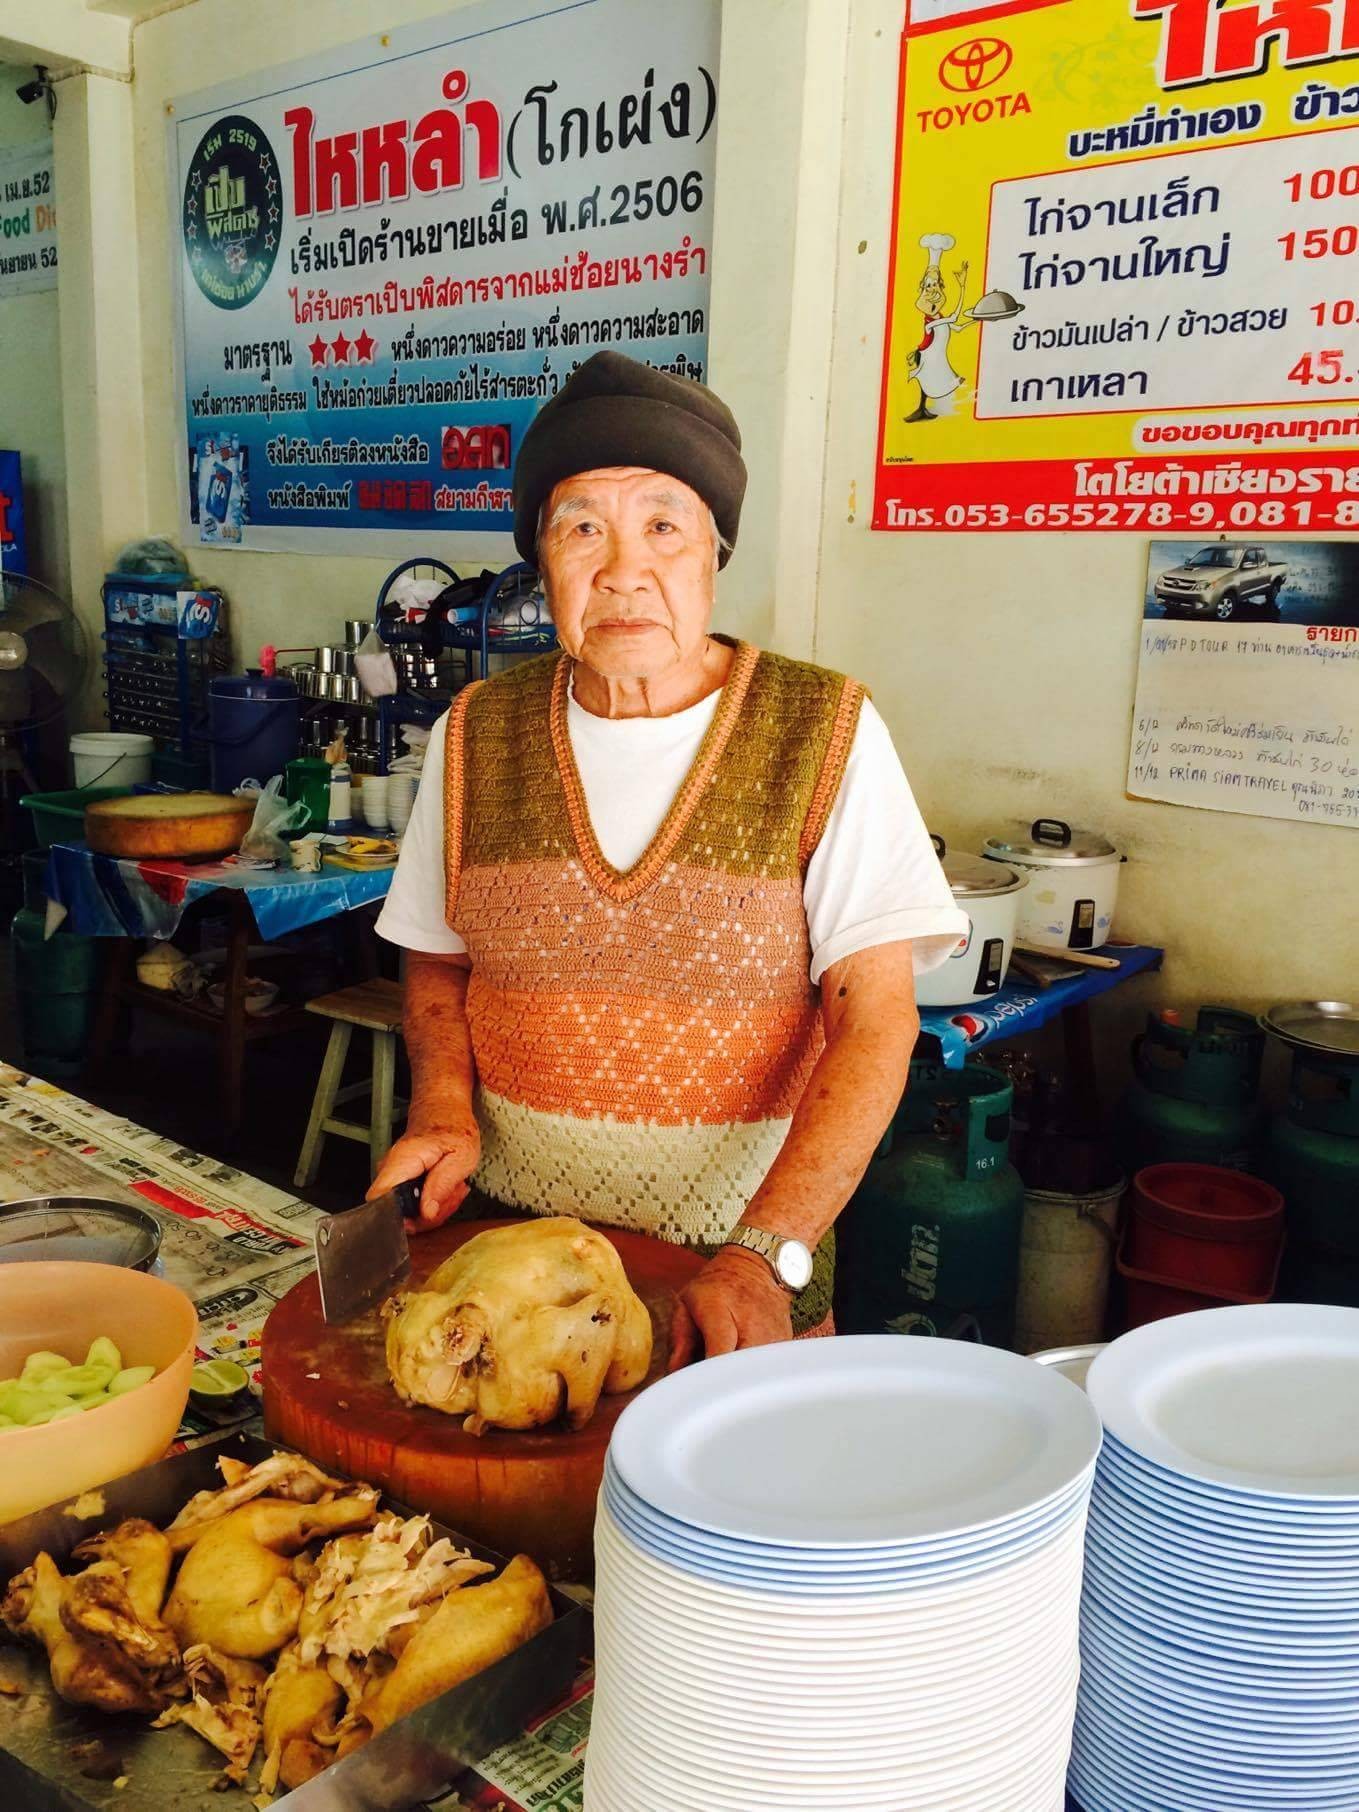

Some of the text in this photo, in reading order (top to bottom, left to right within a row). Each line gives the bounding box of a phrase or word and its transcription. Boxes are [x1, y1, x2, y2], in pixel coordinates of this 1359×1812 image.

[917, 92, 1032, 134] TOYOTA
[1069, 107, 1262, 156] บะหมี่ทำเอง
[228, 128, 257, 152] 2519
[284, 66, 717, 217] ไหหลำ (โกเผ่ง)
[0, 207, 31, 239] ood
[291, 170, 703, 275] เริ่มเปิดร้านขายเมื่อ พ.ศ.2506
[1024, 176, 1220, 236] ไก่จานเล็ก
[41, 246, 58, 268] 52
[1019, 232, 1231, 291] ไก่จานใหญ่
[290, 236, 706, 324] ได้รับตราเปิบพิสดารจากแม่ช้อยนางรำ
[224, 306, 704, 383] มาตรฐาน หนึ่งดาวความอร่อย หนึ่งดาวความสะอาด
[1012, 317, 1149, 350] ข้าวมันเปล่า
[1177, 307, 1288, 338] ข้าวสวย
[1010, 370, 1148, 402] เกาเหลา
[1288, 349, 1359, 385] 45.
[1142, 411, 1359, 445] ขอขอบคุณทุกท
[1310, 757, 1333, 773] 30
[976, 1155, 995, 1170] 16.1
